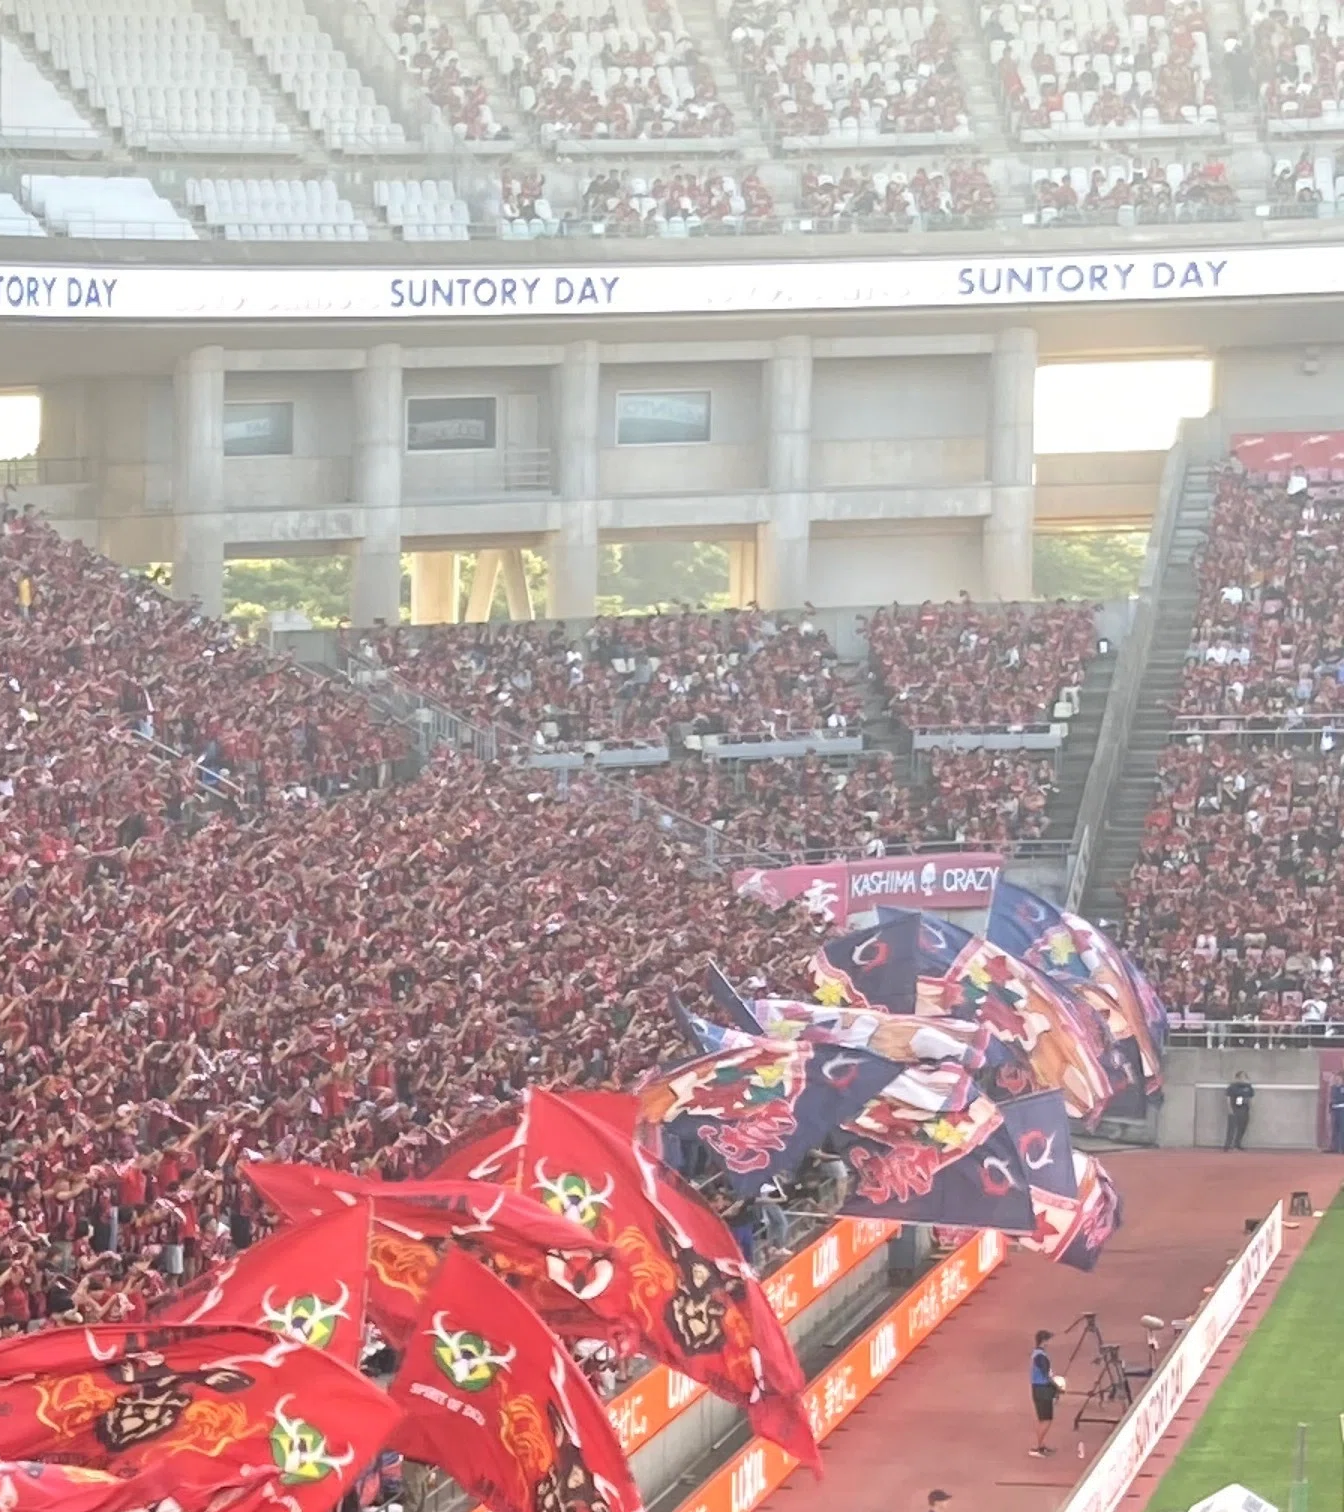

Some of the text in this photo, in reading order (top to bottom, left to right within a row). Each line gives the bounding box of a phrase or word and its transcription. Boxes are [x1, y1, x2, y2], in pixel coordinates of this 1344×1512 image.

[66, 276, 118, 309] DAY
[389, 276, 540, 309] SUNTORY
[553, 275, 621, 306] DAY
[956, 264, 1134, 297] SUNTORY
[1152, 259, 1229, 291] DAY
[851, 866, 1000, 898] KASHIMA CRAZY
